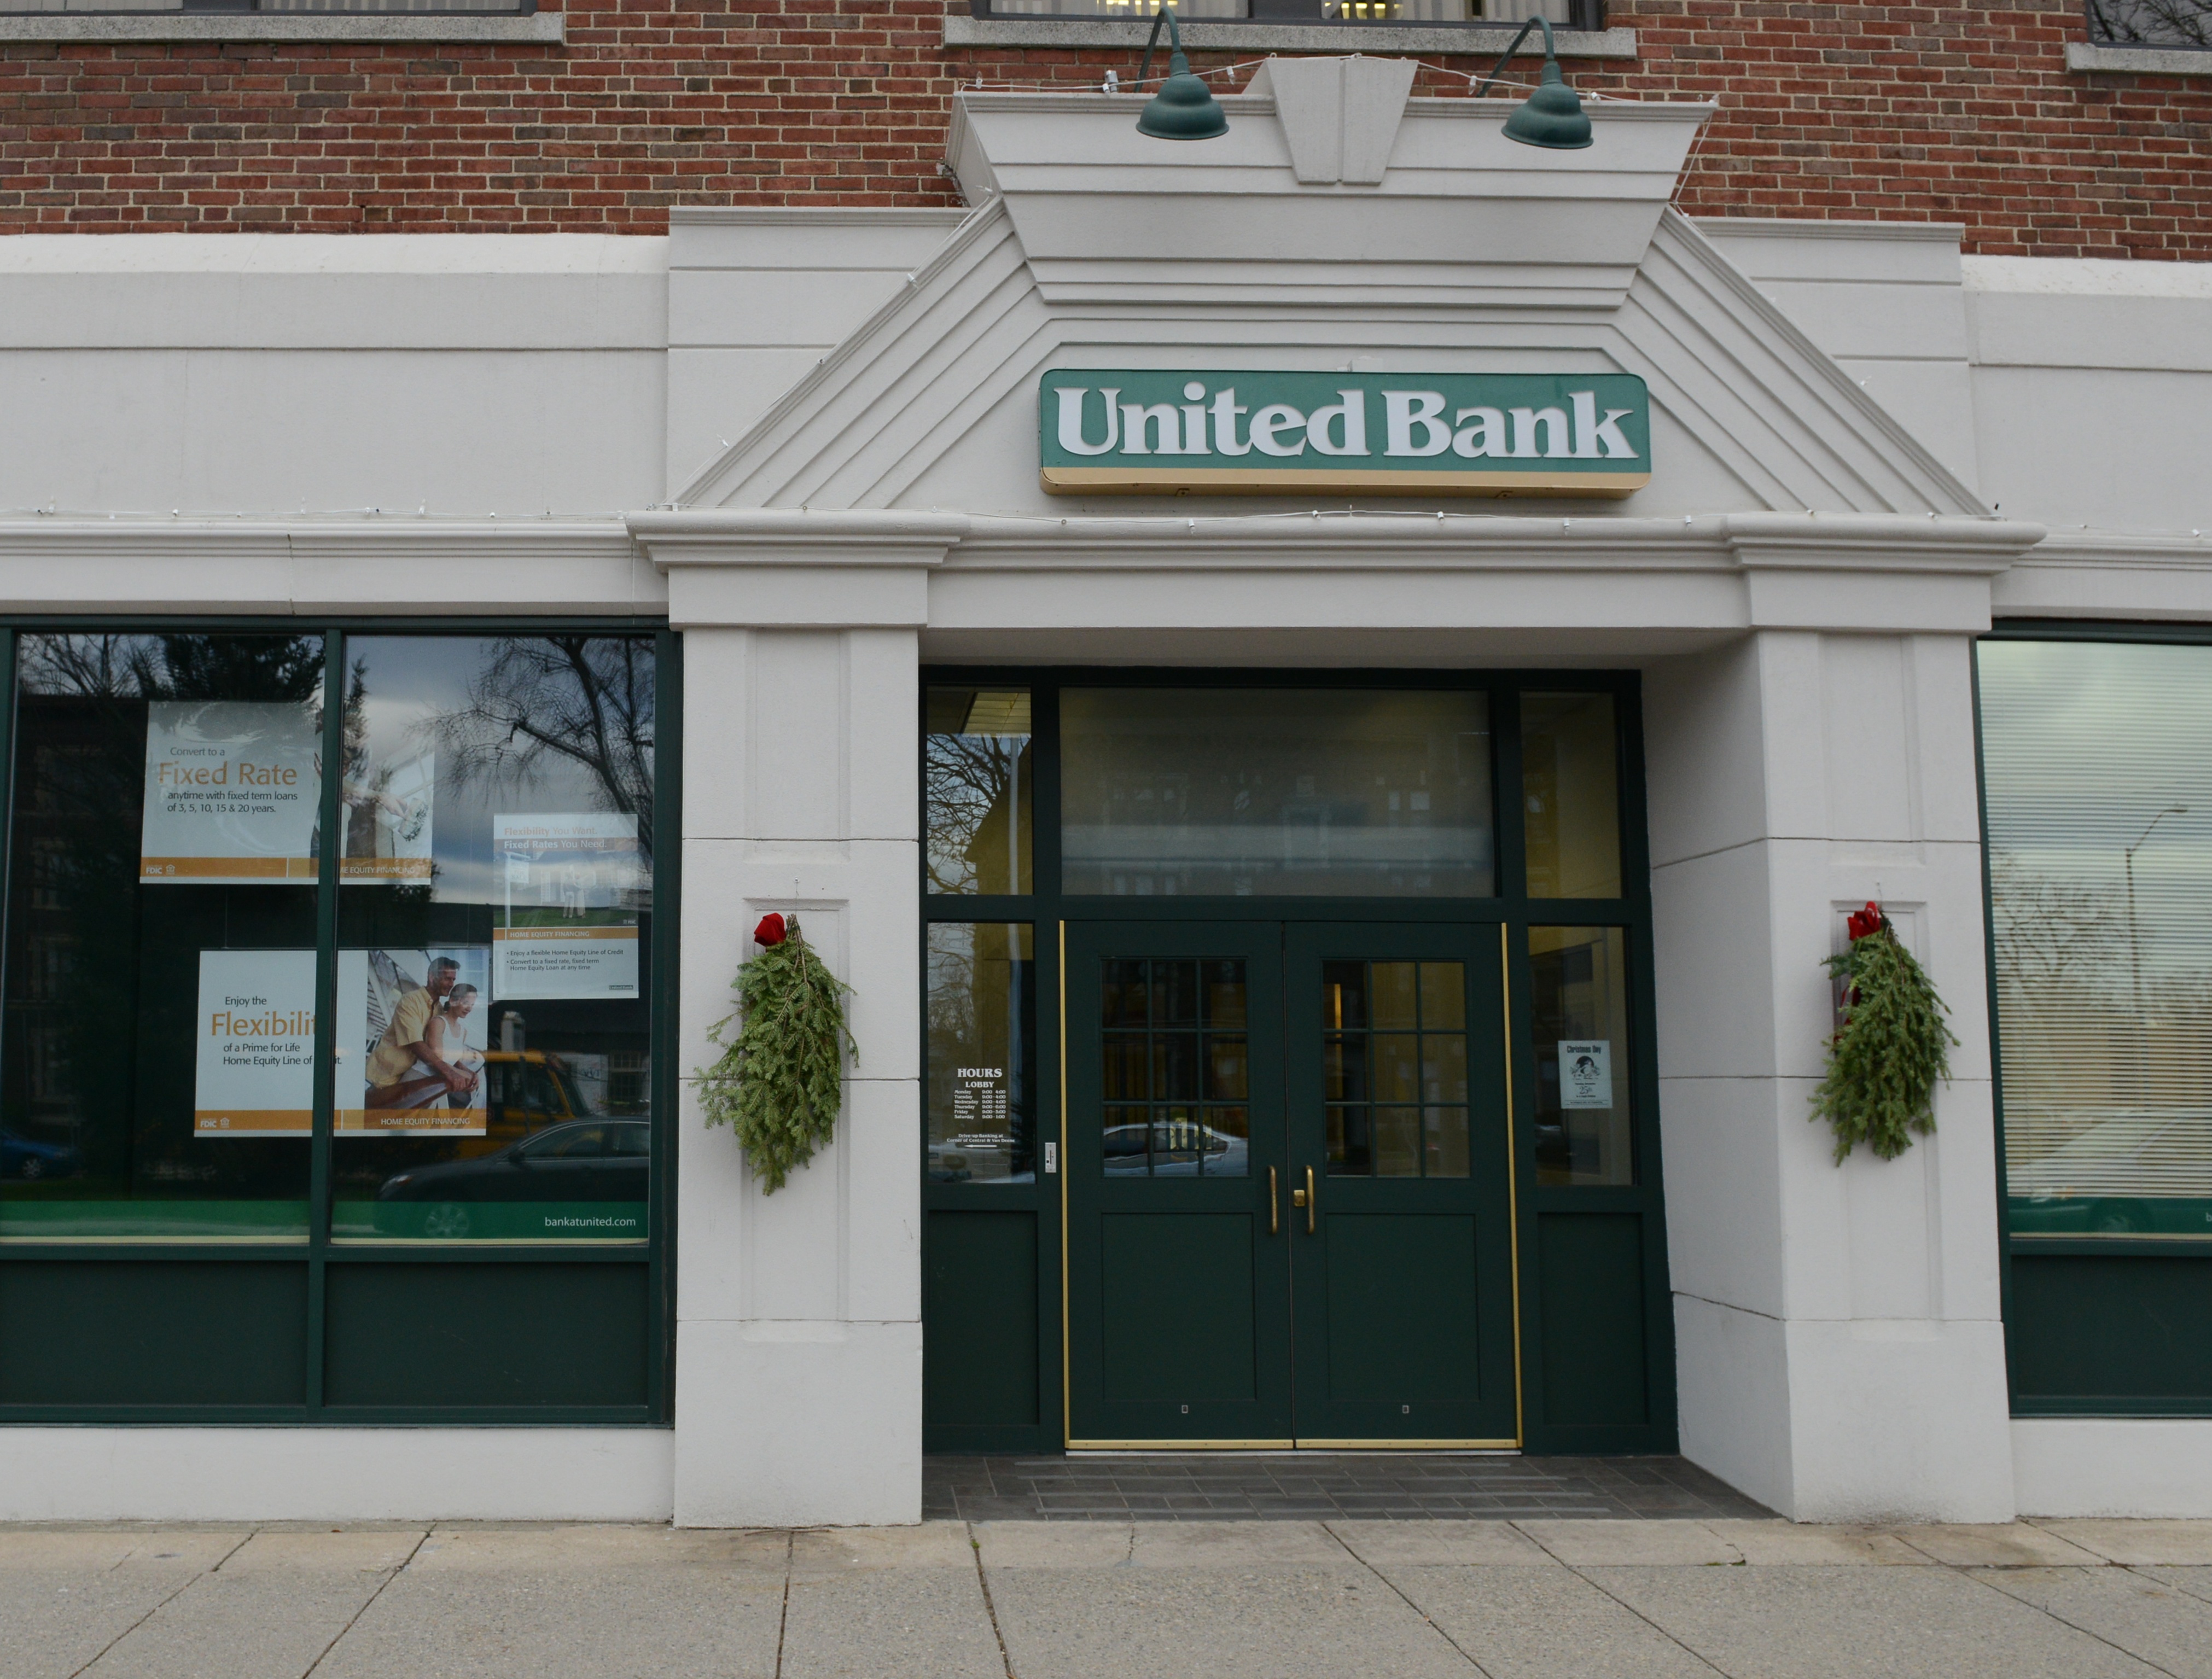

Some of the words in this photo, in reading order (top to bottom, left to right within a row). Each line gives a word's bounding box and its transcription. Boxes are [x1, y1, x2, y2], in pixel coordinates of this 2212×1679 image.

[1052, 380, 1372, 458] United
[1381, 389, 1640, 460] Bank
[170, 747, 205, 756] Convert
[208, 748, 217, 756] to
[159, 760, 228, 785] Fixed
[238, 763, 298, 785] Rate
[168, 791, 203, 802] anytime
[206, 791, 225, 800] with
[228, 791, 249, 800] fixed
[274, 791, 298, 800] loans
[167, 803, 176, 812] of
[179, 804, 187, 813] 3,
[189, 804, 197, 813] 5,
[201, 804, 213, 813] 10,
[217, 804, 226, 812] 15
[229, 804, 235, 812] &
[238, 804, 249, 812] 20
[252, 805, 276, 814] years.
[504, 827, 550, 836] Flexibility
[504, 840, 529, 849] Fixed
[533, 840, 558, 849] Rates
[581, 840, 607, 848] Need.
[225, 996, 250, 1007] Enjoy
[252, 996, 267, 1005] the
[212, 1011, 316, 1036] Flexibili
[223, 1043, 232, 1052] of
[243, 1043, 268, 1052] Prime
[271, 1043, 282, 1052] for
[285, 1043, 300, 1052] Life
[223, 1057, 251, 1065] Home
[254, 1056, 280, 1066] Equity
[283, 1056, 301, 1064] Line
[303, 1056, 312, 1064] of
[957, 1068, 1003, 1077] HOURS
[545, 1216, 636, 1226] bankatunited.com
